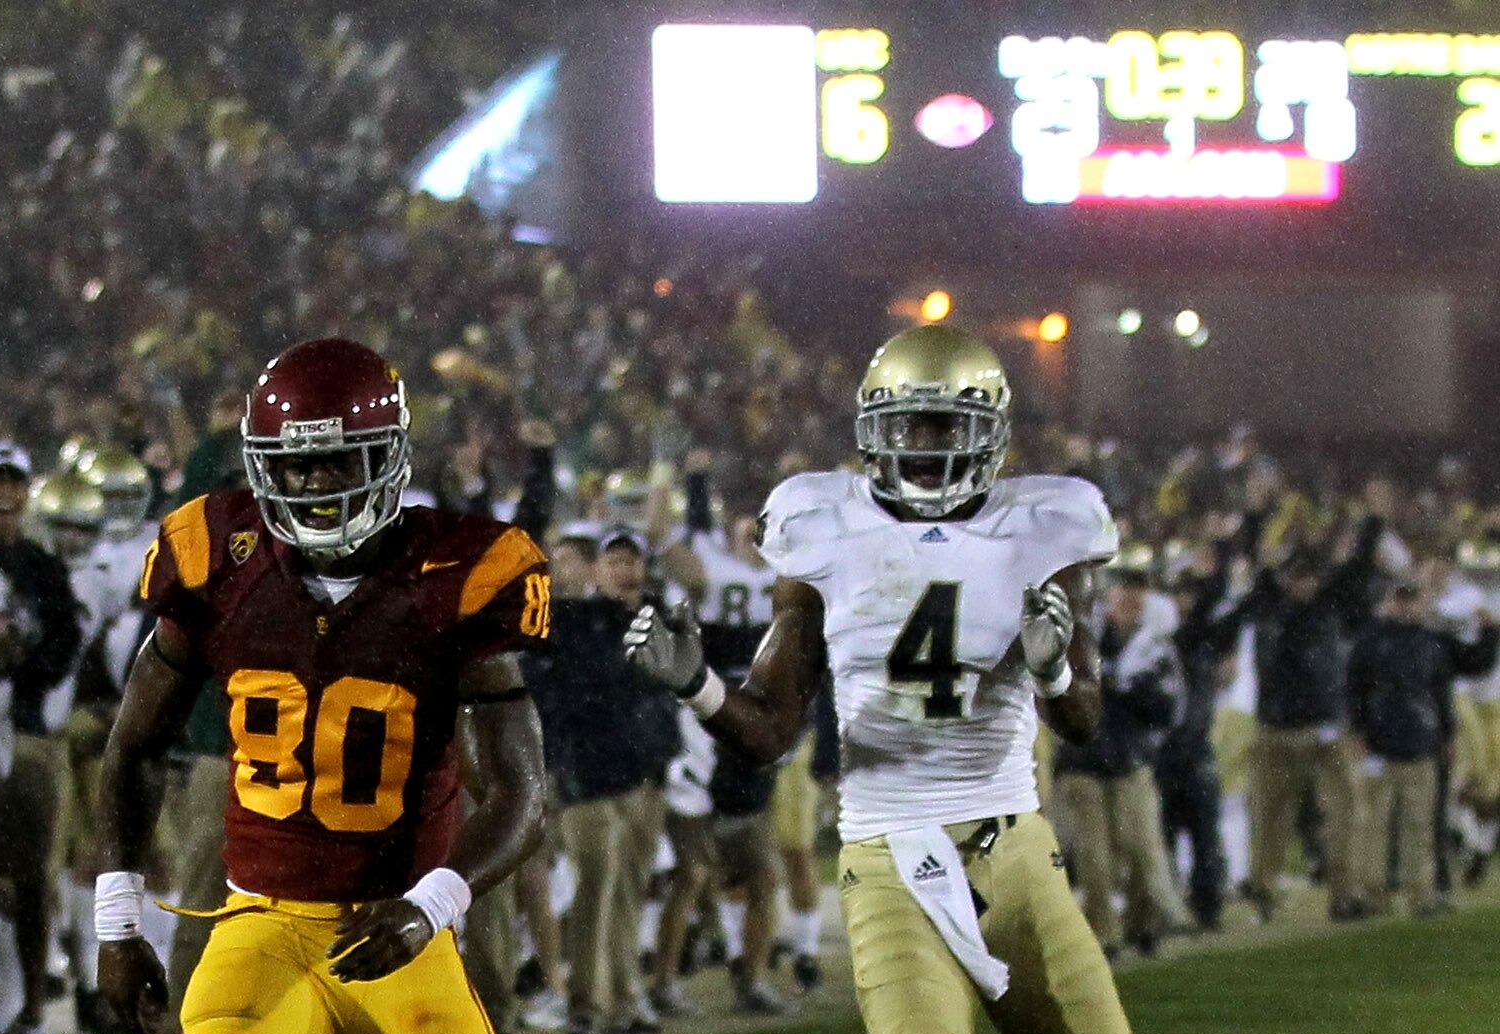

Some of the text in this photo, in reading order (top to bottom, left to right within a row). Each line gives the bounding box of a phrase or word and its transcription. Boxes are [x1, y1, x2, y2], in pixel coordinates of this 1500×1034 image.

[296, 422, 327, 433] USC
[884, 579, 963, 720] 4
[227, 669, 417, 832] 80
